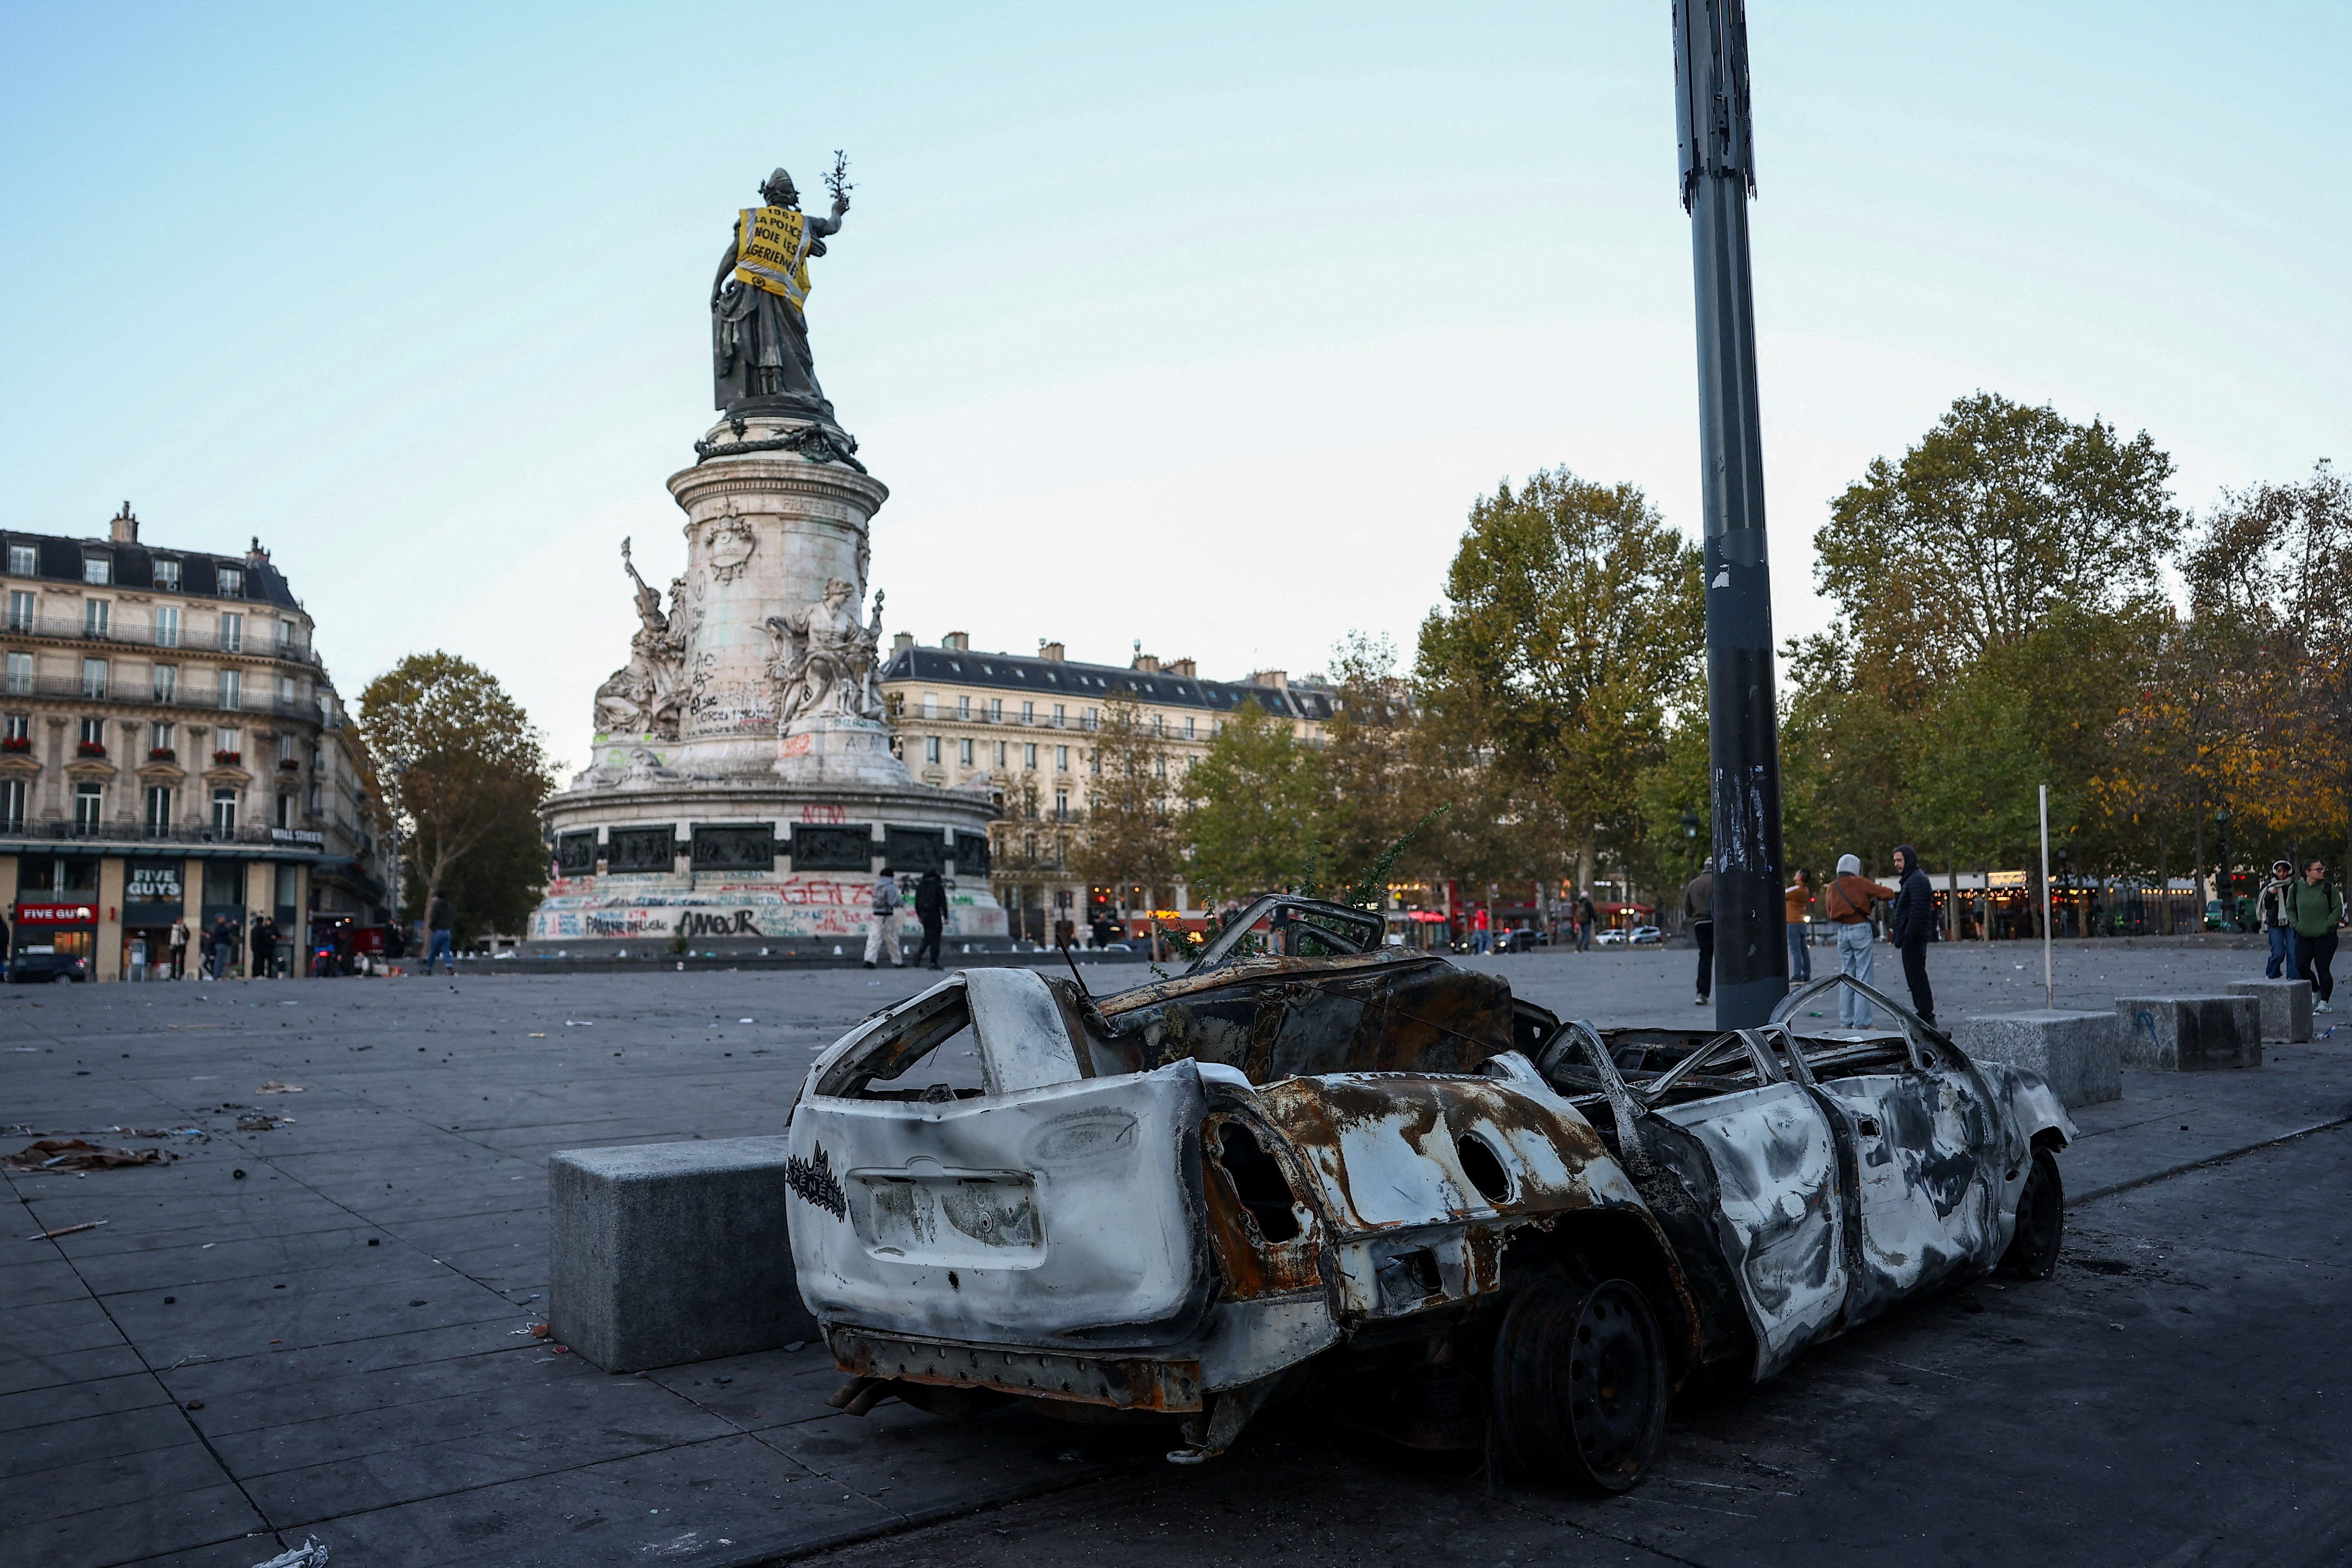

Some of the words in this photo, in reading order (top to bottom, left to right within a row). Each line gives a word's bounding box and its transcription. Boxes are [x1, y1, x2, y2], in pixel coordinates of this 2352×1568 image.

[768, 208, 795, 222] 1961
[755, 216, 767, 224] LA
[770, 217, 802, 241] POLICE
[755, 227, 780, 244] NOIE
[783, 237, 798, 256] LES
[133, 869, 175, 882] FIVE
[128, 882, 180, 895] GUYS
[780, 877, 844, 905] GEN
[24, 909, 53, 919] FIVE
[679, 910, 764, 937] AMOUR
